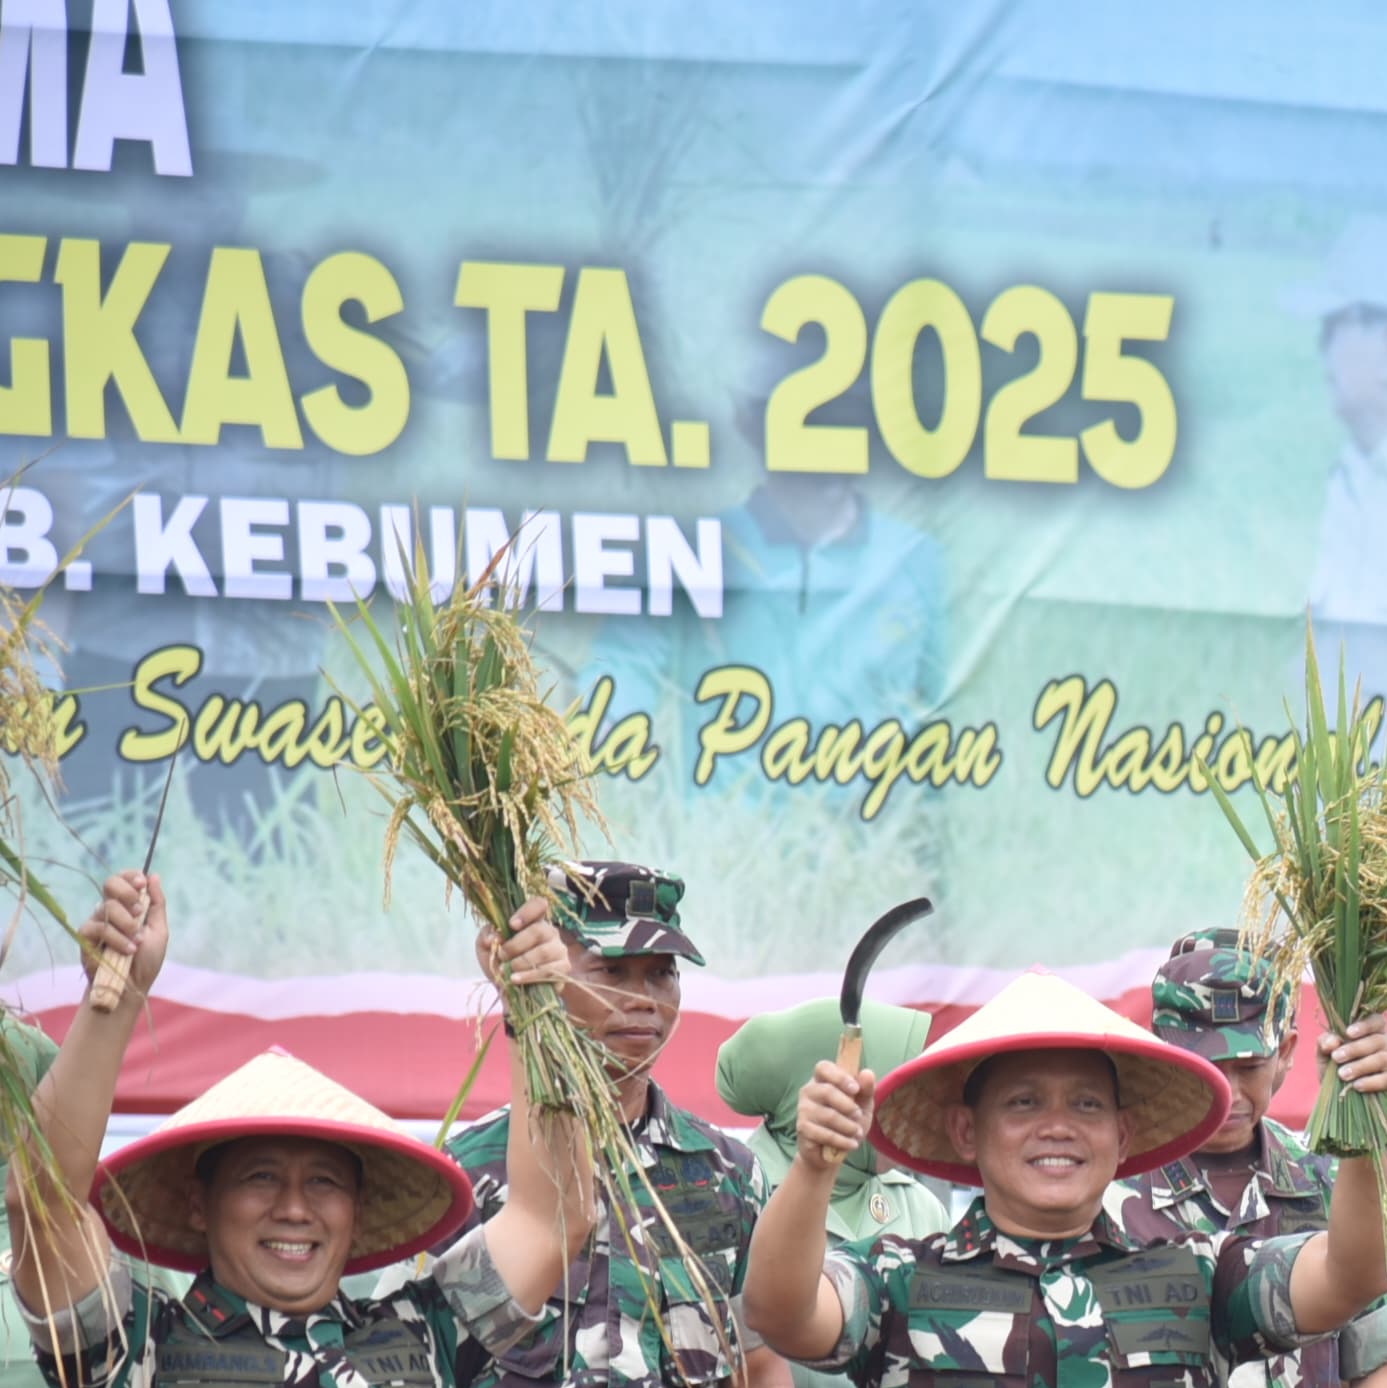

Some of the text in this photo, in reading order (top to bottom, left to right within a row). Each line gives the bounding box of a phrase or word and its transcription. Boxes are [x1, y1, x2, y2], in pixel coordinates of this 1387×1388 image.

[454, 260, 710, 468] TA.
[761, 274, 1177, 490] 2025
[132, 492, 725, 619] KEBUMEN
[695, 664, 1003, 820] Pangan
[1032, 674, 1386, 799] Nasionl
[1105, 1282, 1199, 1306] TNI AD
